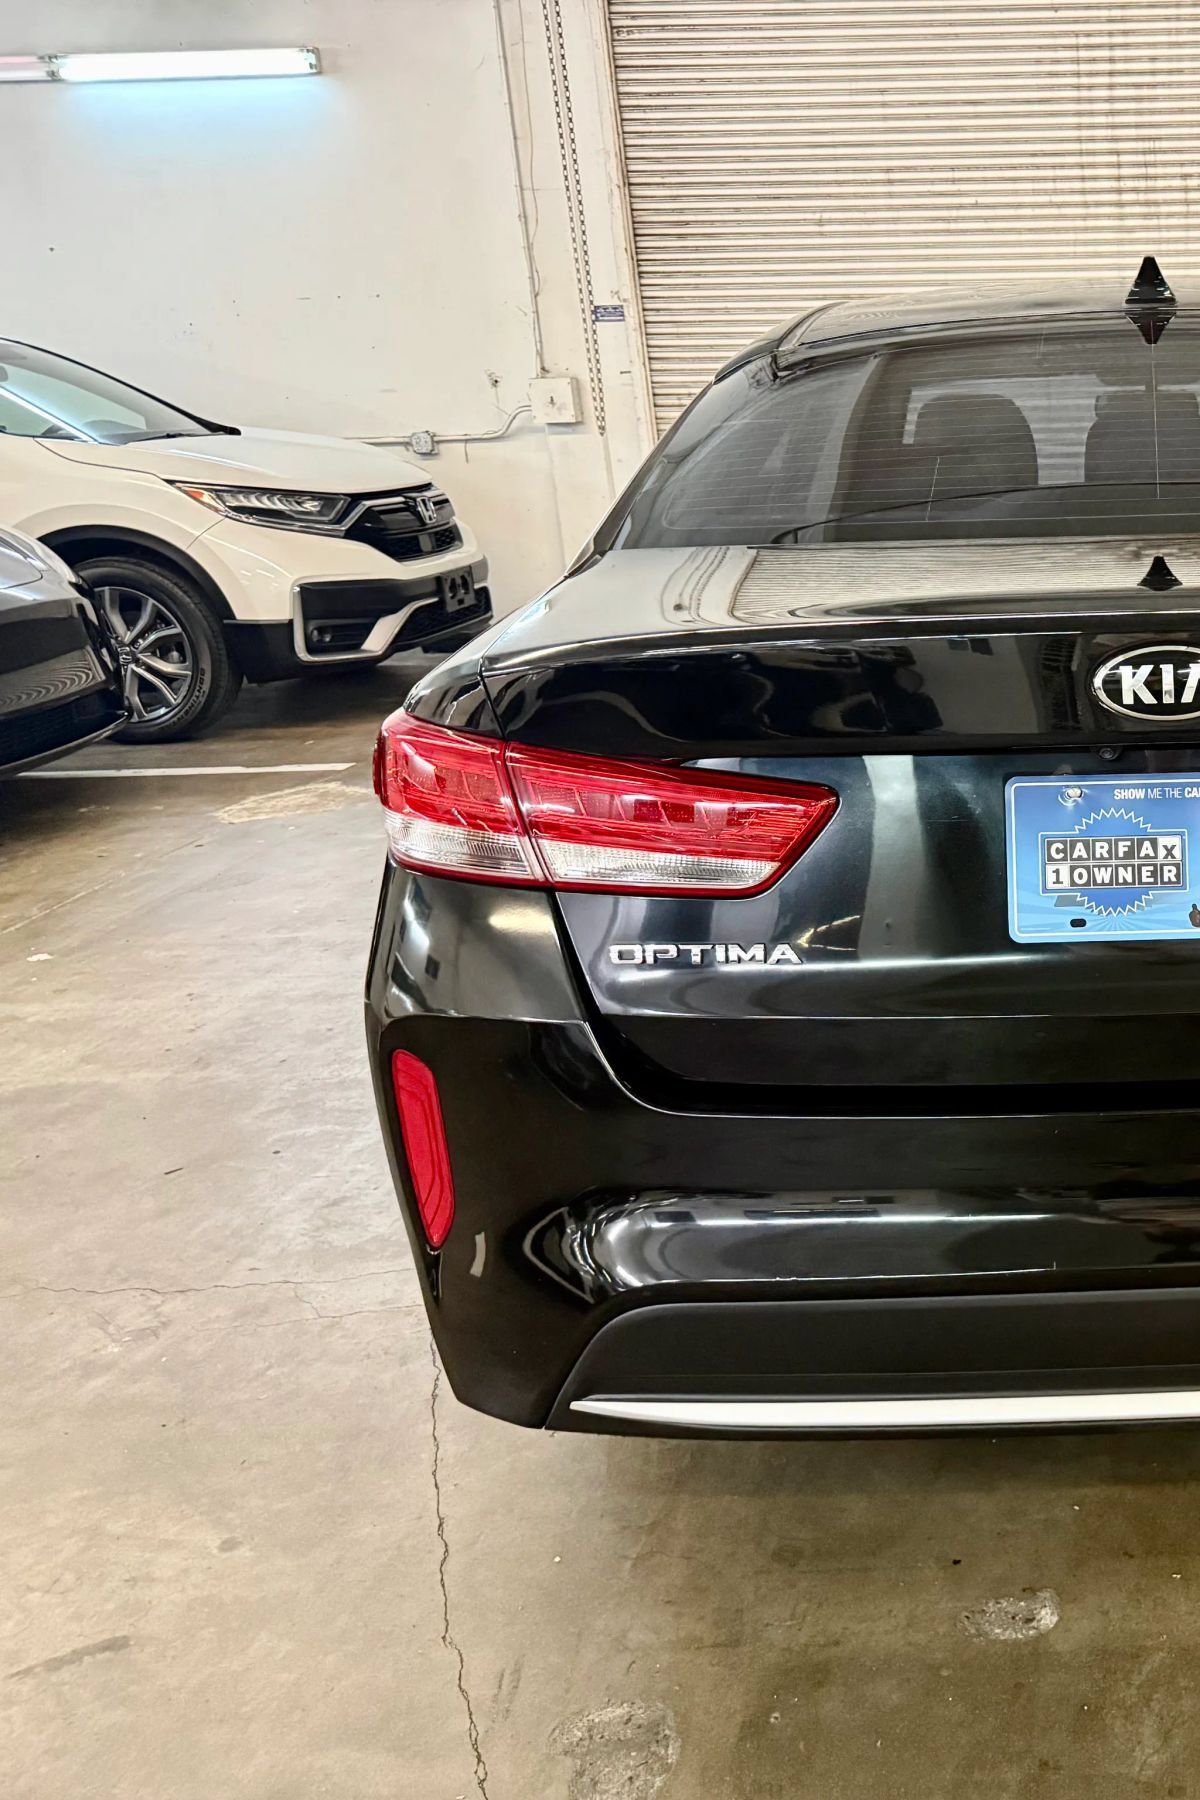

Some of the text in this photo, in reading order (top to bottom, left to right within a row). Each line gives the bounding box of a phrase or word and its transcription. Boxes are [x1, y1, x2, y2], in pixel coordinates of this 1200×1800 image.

[1113, 788, 1146, 800] SHOW
[1147, 788, 1163, 799] ME
[1163, 787, 1183, 799] THE
[1050, 840, 1177, 860] CARFAX
[1052, 865, 1178, 885] 1 OWNER
[609, 943, 804, 966] OPTIMA
